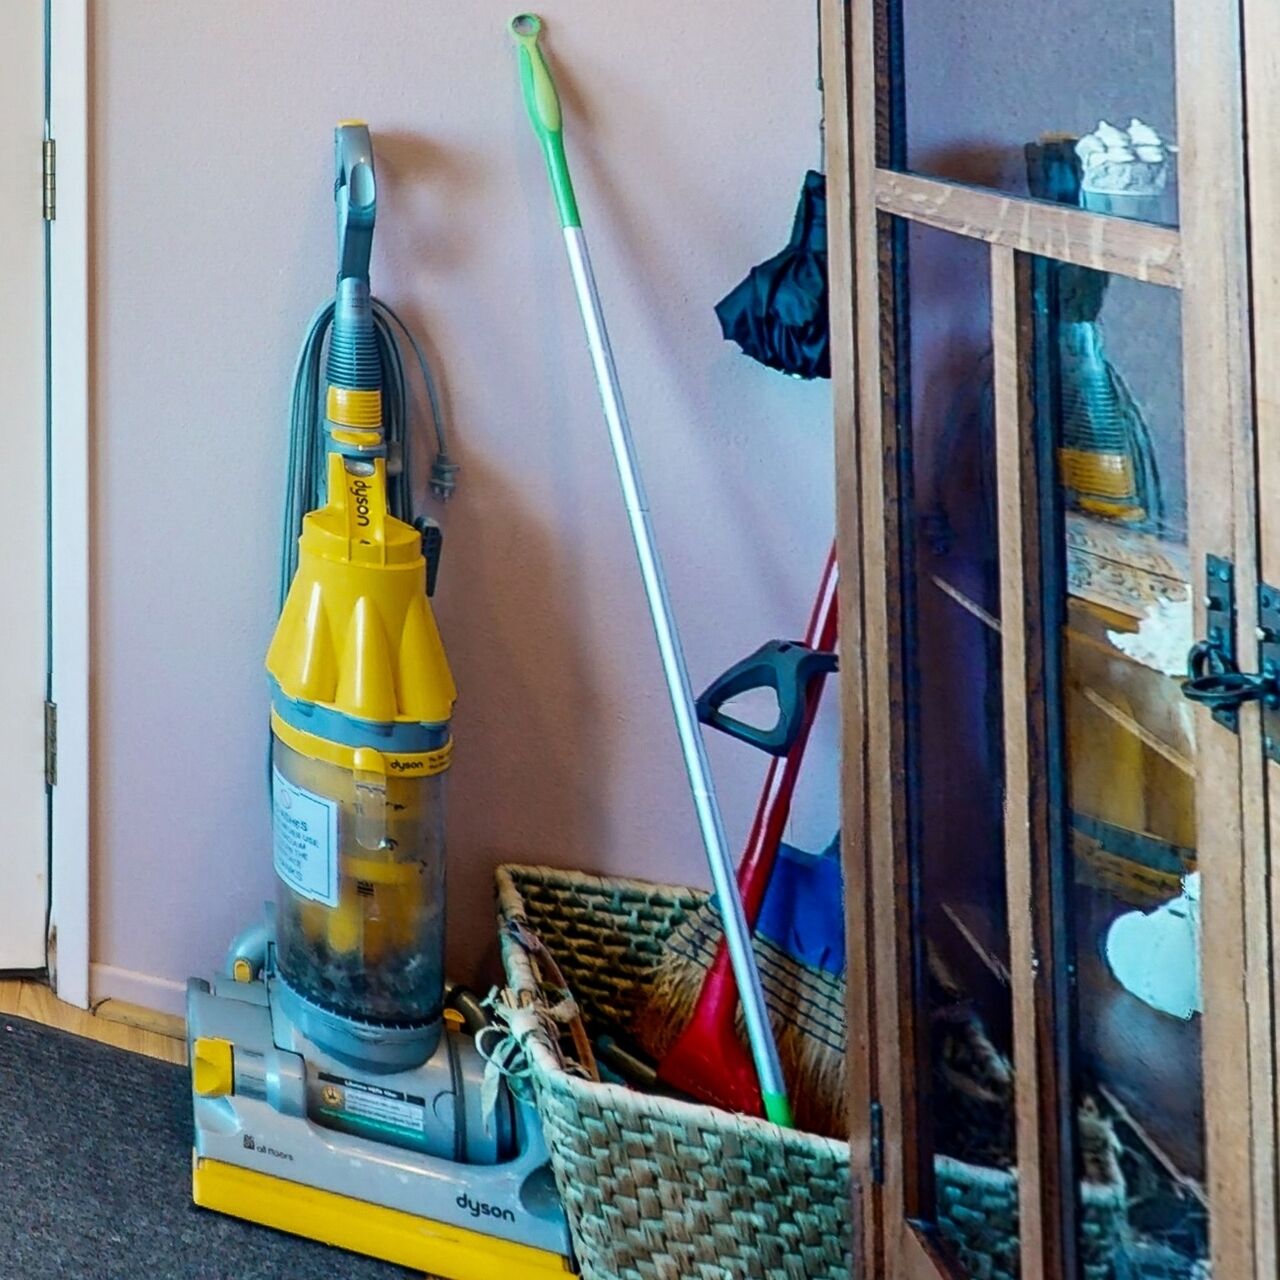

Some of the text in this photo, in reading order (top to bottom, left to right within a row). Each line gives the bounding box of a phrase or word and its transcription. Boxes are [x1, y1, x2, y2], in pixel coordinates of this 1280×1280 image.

[349, 479, 372, 527] dyson
[390, 758, 424, 772] dyson
[455, 1192, 516, 1222] dyson
